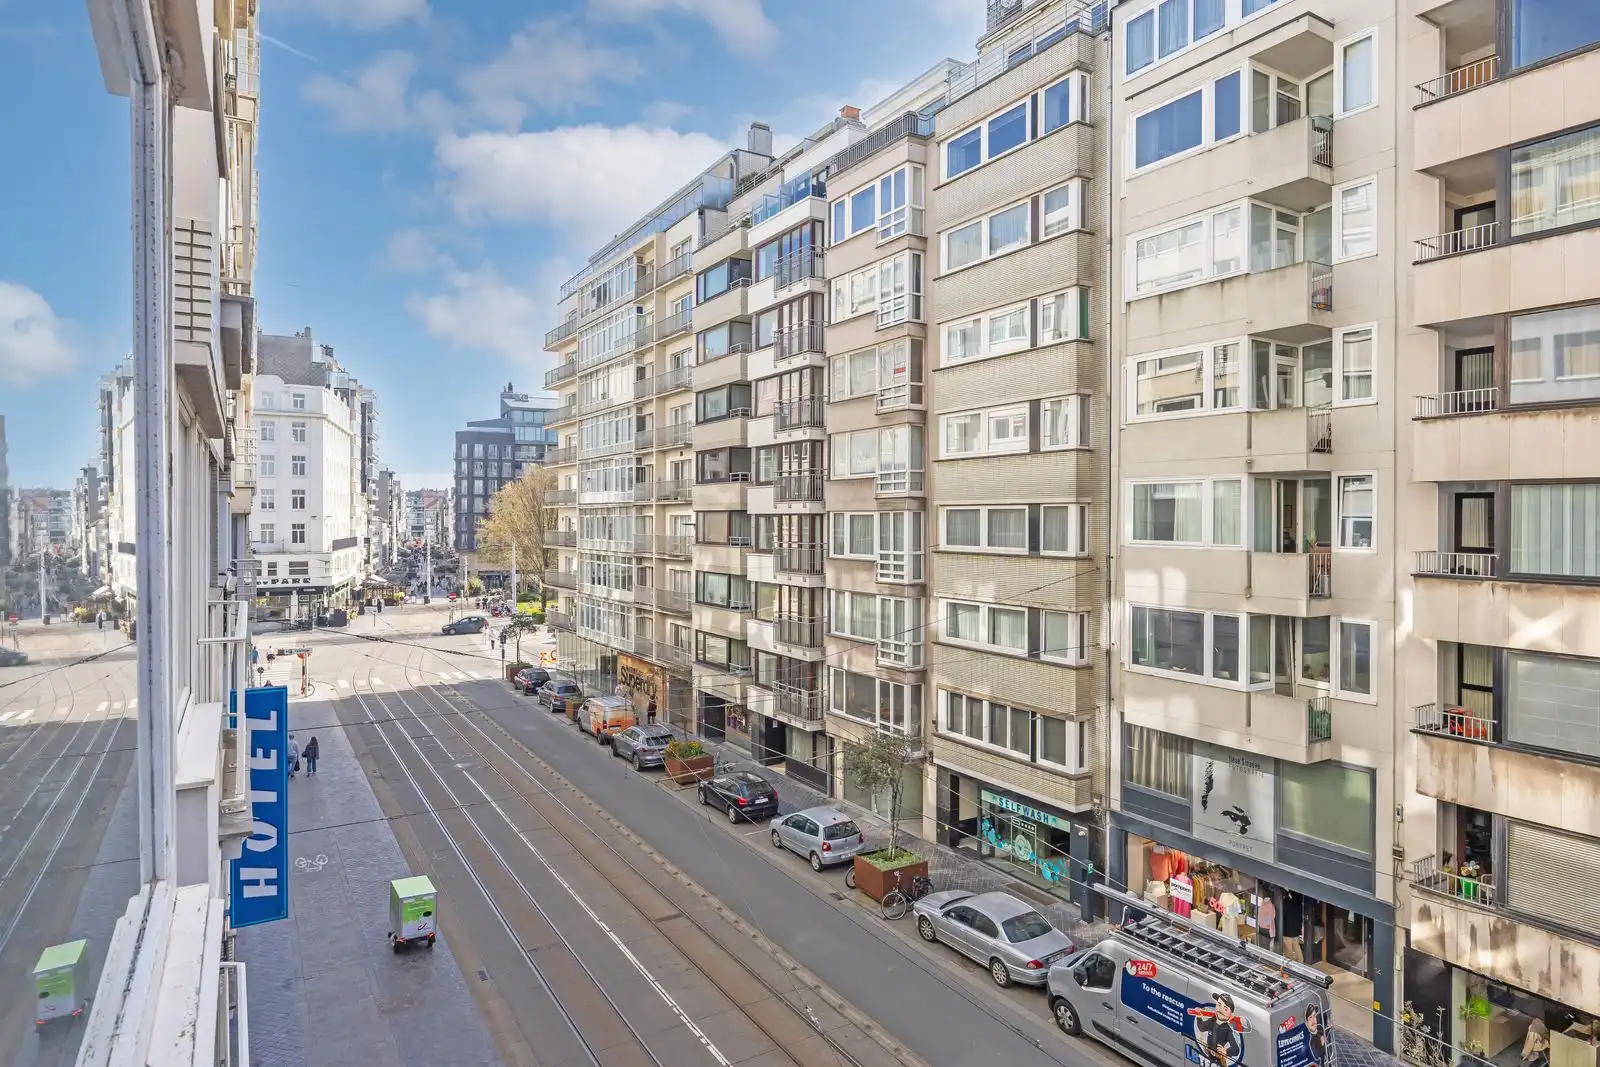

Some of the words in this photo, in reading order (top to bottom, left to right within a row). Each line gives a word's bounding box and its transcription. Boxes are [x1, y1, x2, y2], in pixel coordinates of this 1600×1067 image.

[998, 797, 1049, 824] SELFWASH
[1136, 962, 1153, 971] 24/7
[1142, 982, 1151, 992] To
[1150, 987, 1162, 998] the
[1162, 994, 1185, 1009] rescue
